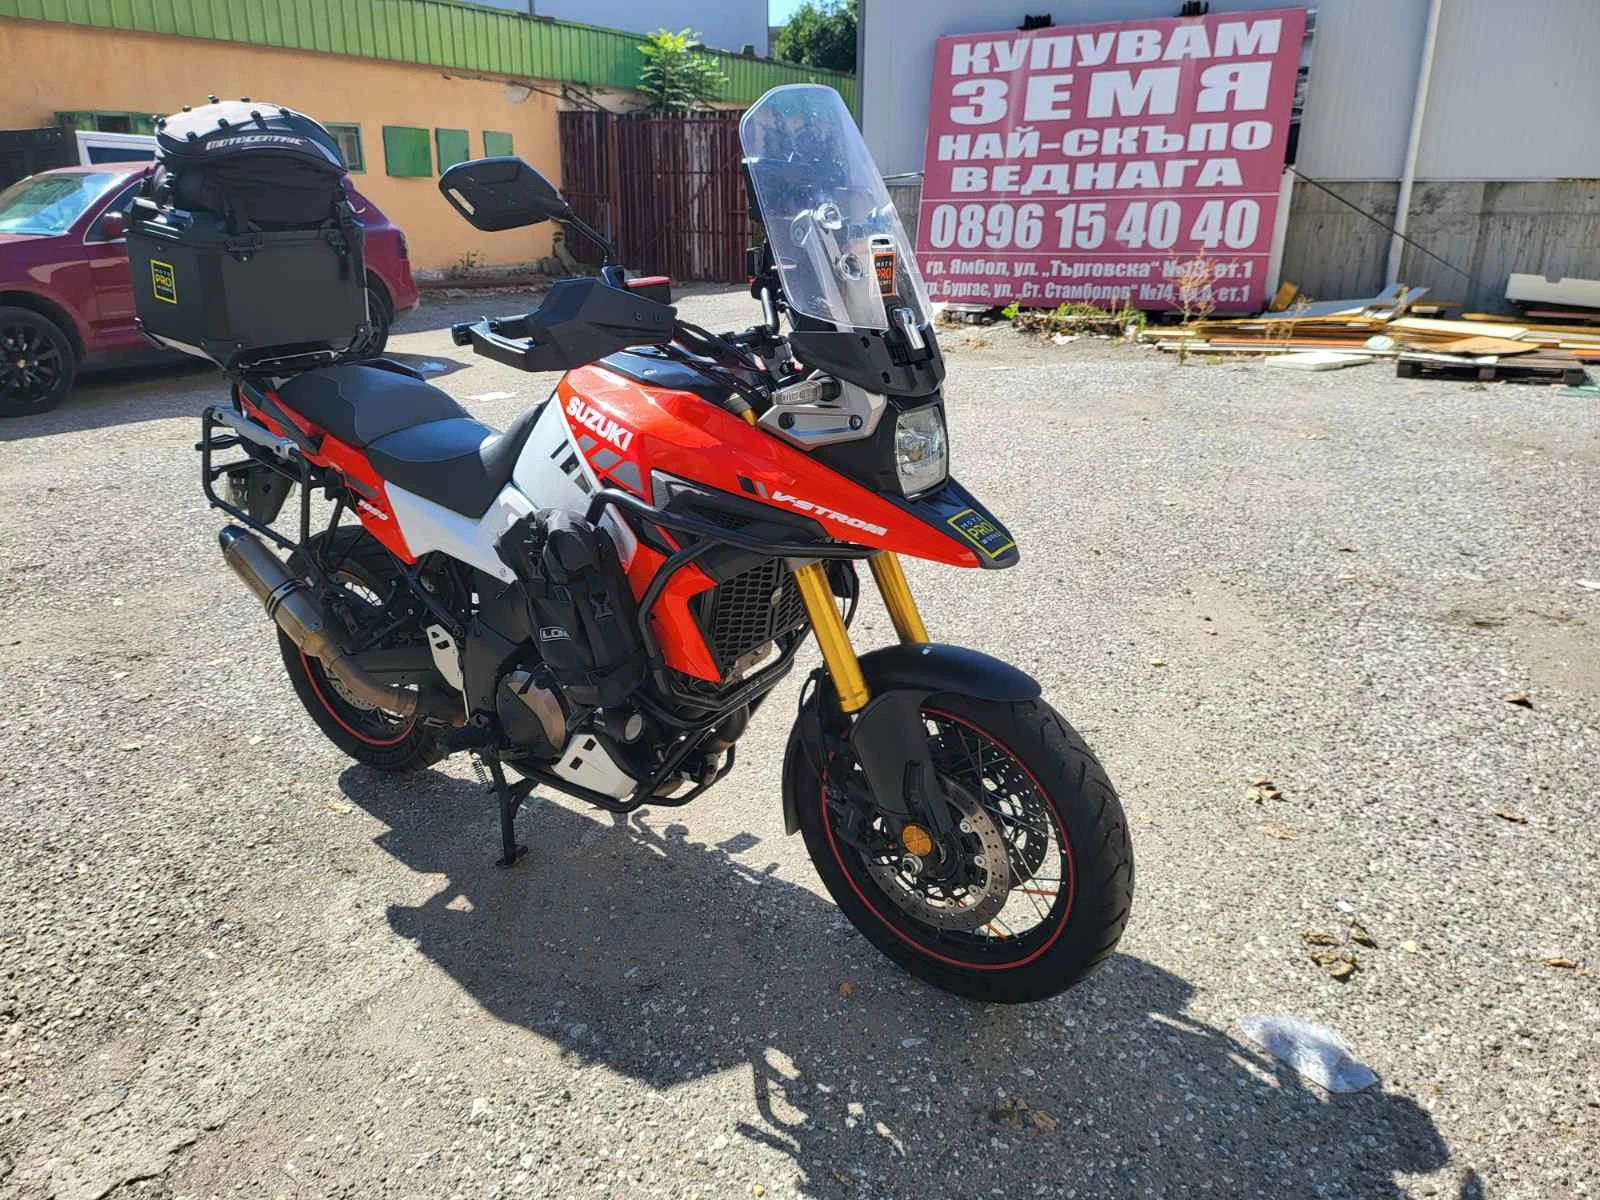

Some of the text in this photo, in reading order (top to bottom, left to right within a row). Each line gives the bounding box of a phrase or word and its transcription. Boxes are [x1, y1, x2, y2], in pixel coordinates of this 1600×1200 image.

[950, 19, 1283, 75] КУПУВАМ
[949, 61, 1273, 126] ЗЕМЯ
[938, 120, 1273, 161] НАЙ-СКЪПО
[950, 158, 1243, 195] ВЕДНАГА
[930, 199, 1260, 249] 0896 15 40 40
[155, 273, 172, 288] PRO
[950, 259, 1009, 276] Ямбол,
[566, 396, 633, 452] SUZUKI
[772, 490, 888, 537] V-STROM
[967, 521, 994, 540] PRO
